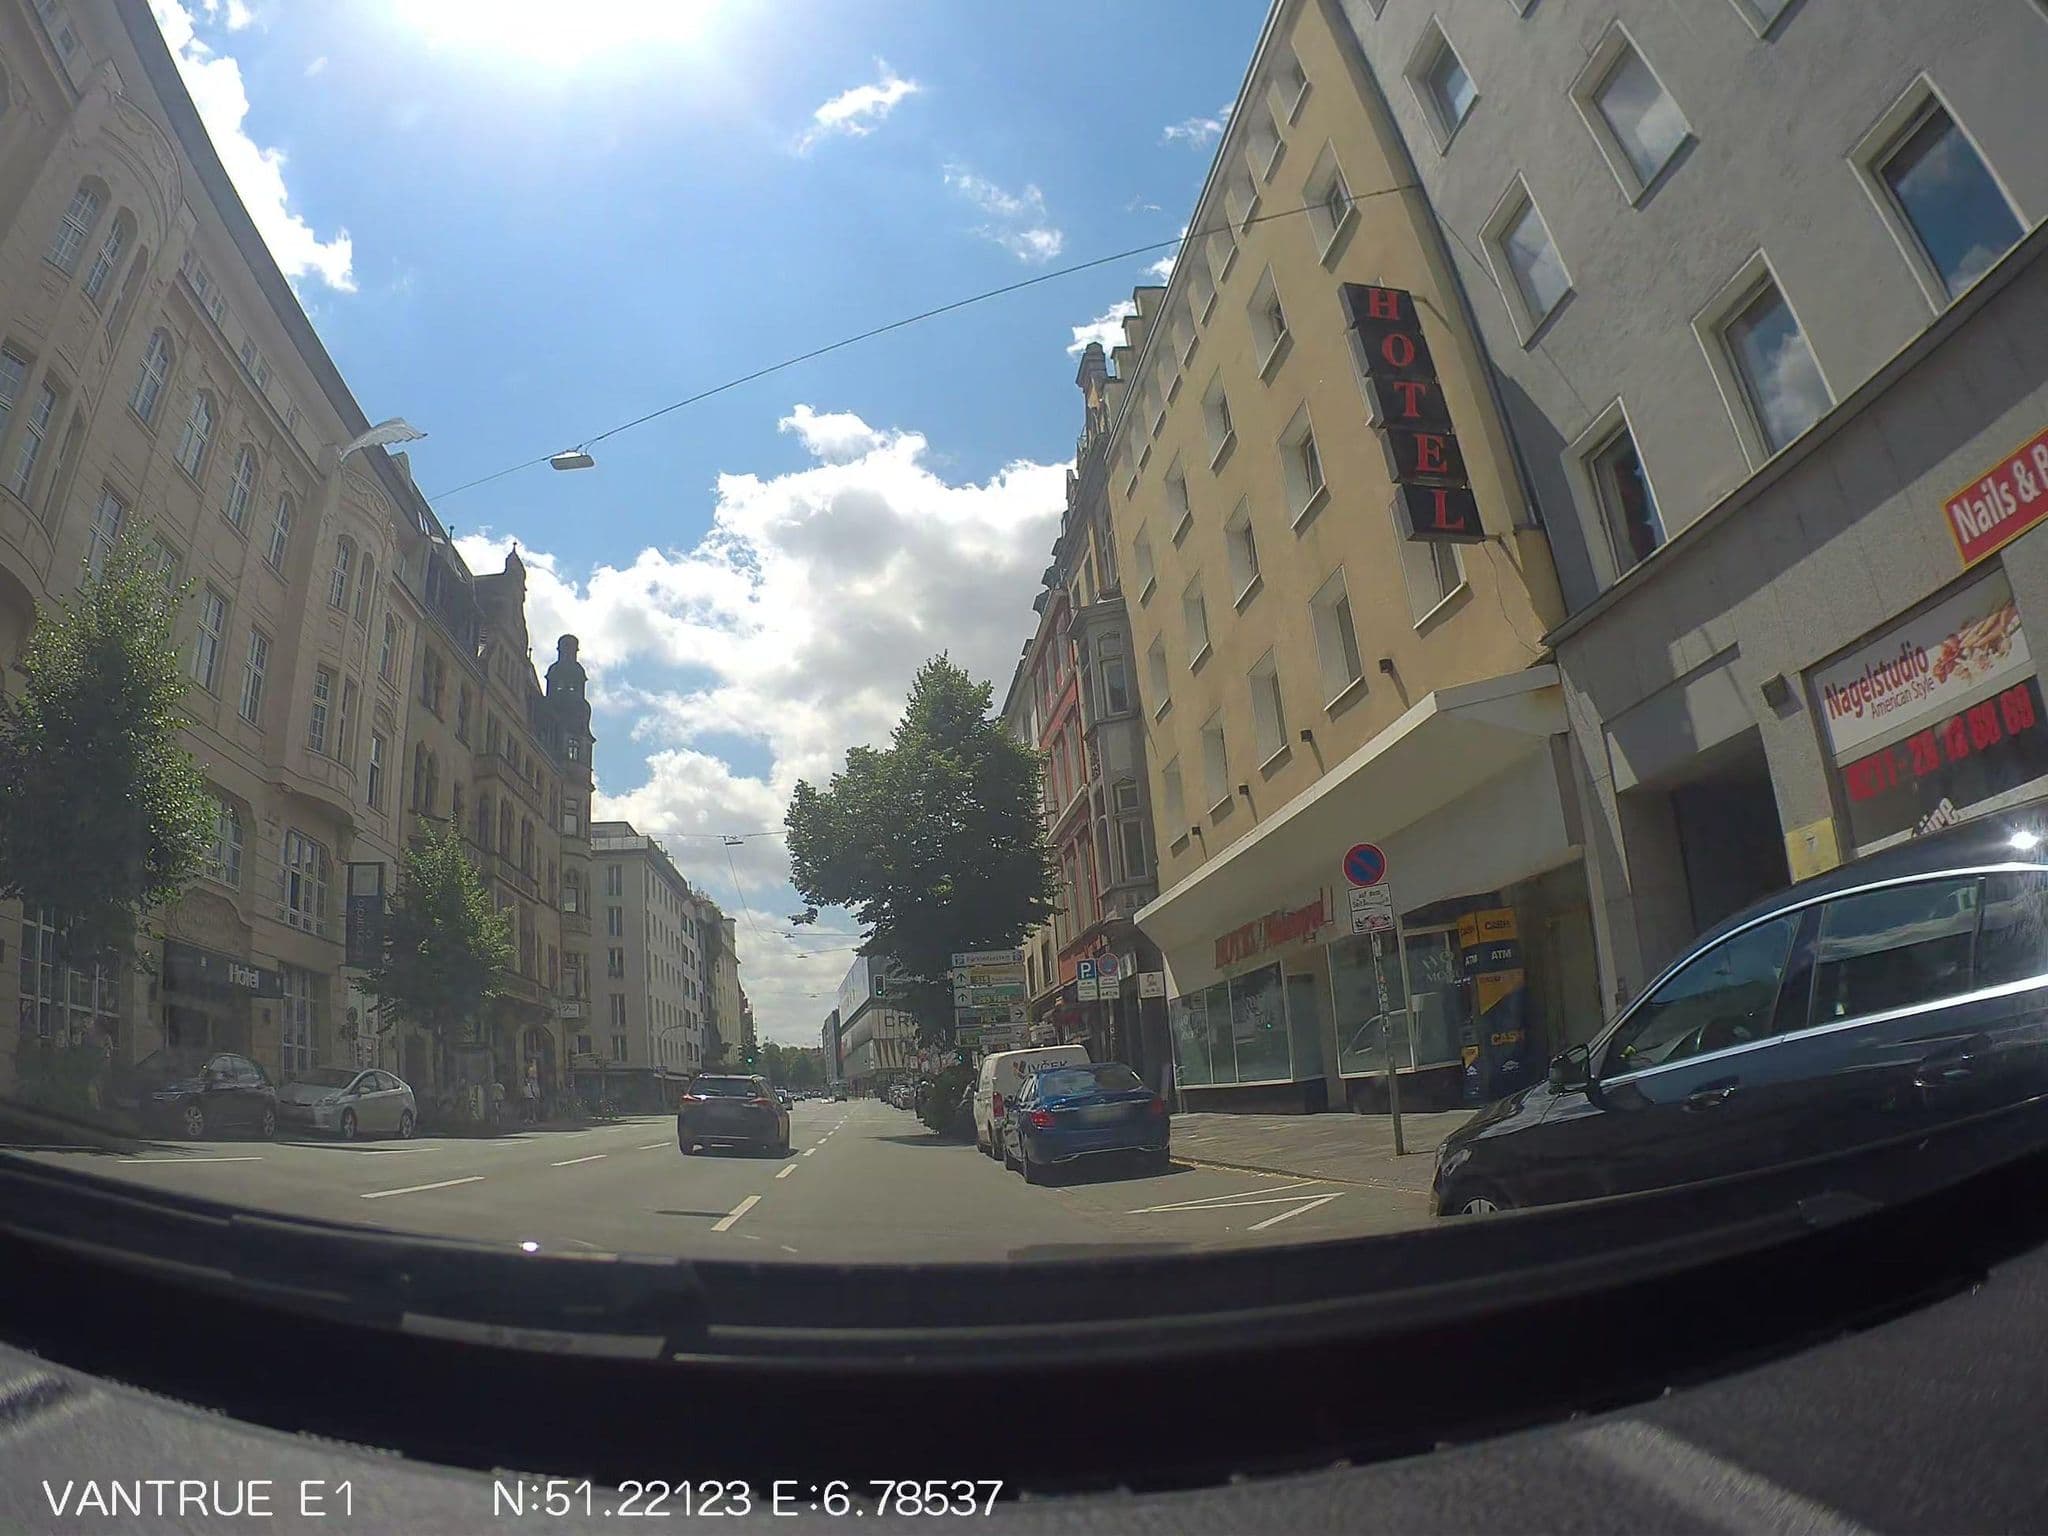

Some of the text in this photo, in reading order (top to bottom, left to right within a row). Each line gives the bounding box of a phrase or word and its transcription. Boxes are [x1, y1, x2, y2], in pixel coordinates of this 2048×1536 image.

[1367, 288, 1465, 529] HOTEL
[1952, 476, 2018, 544] Nails
[2013, 459, 2042, 503] &
[1823, 641, 1929, 720] Nagelstudio
[1870, 675, 1936, 720] American Style
[228, 962, 261, 990] Hotel
[1491, 948, 1513, 961] ATM
